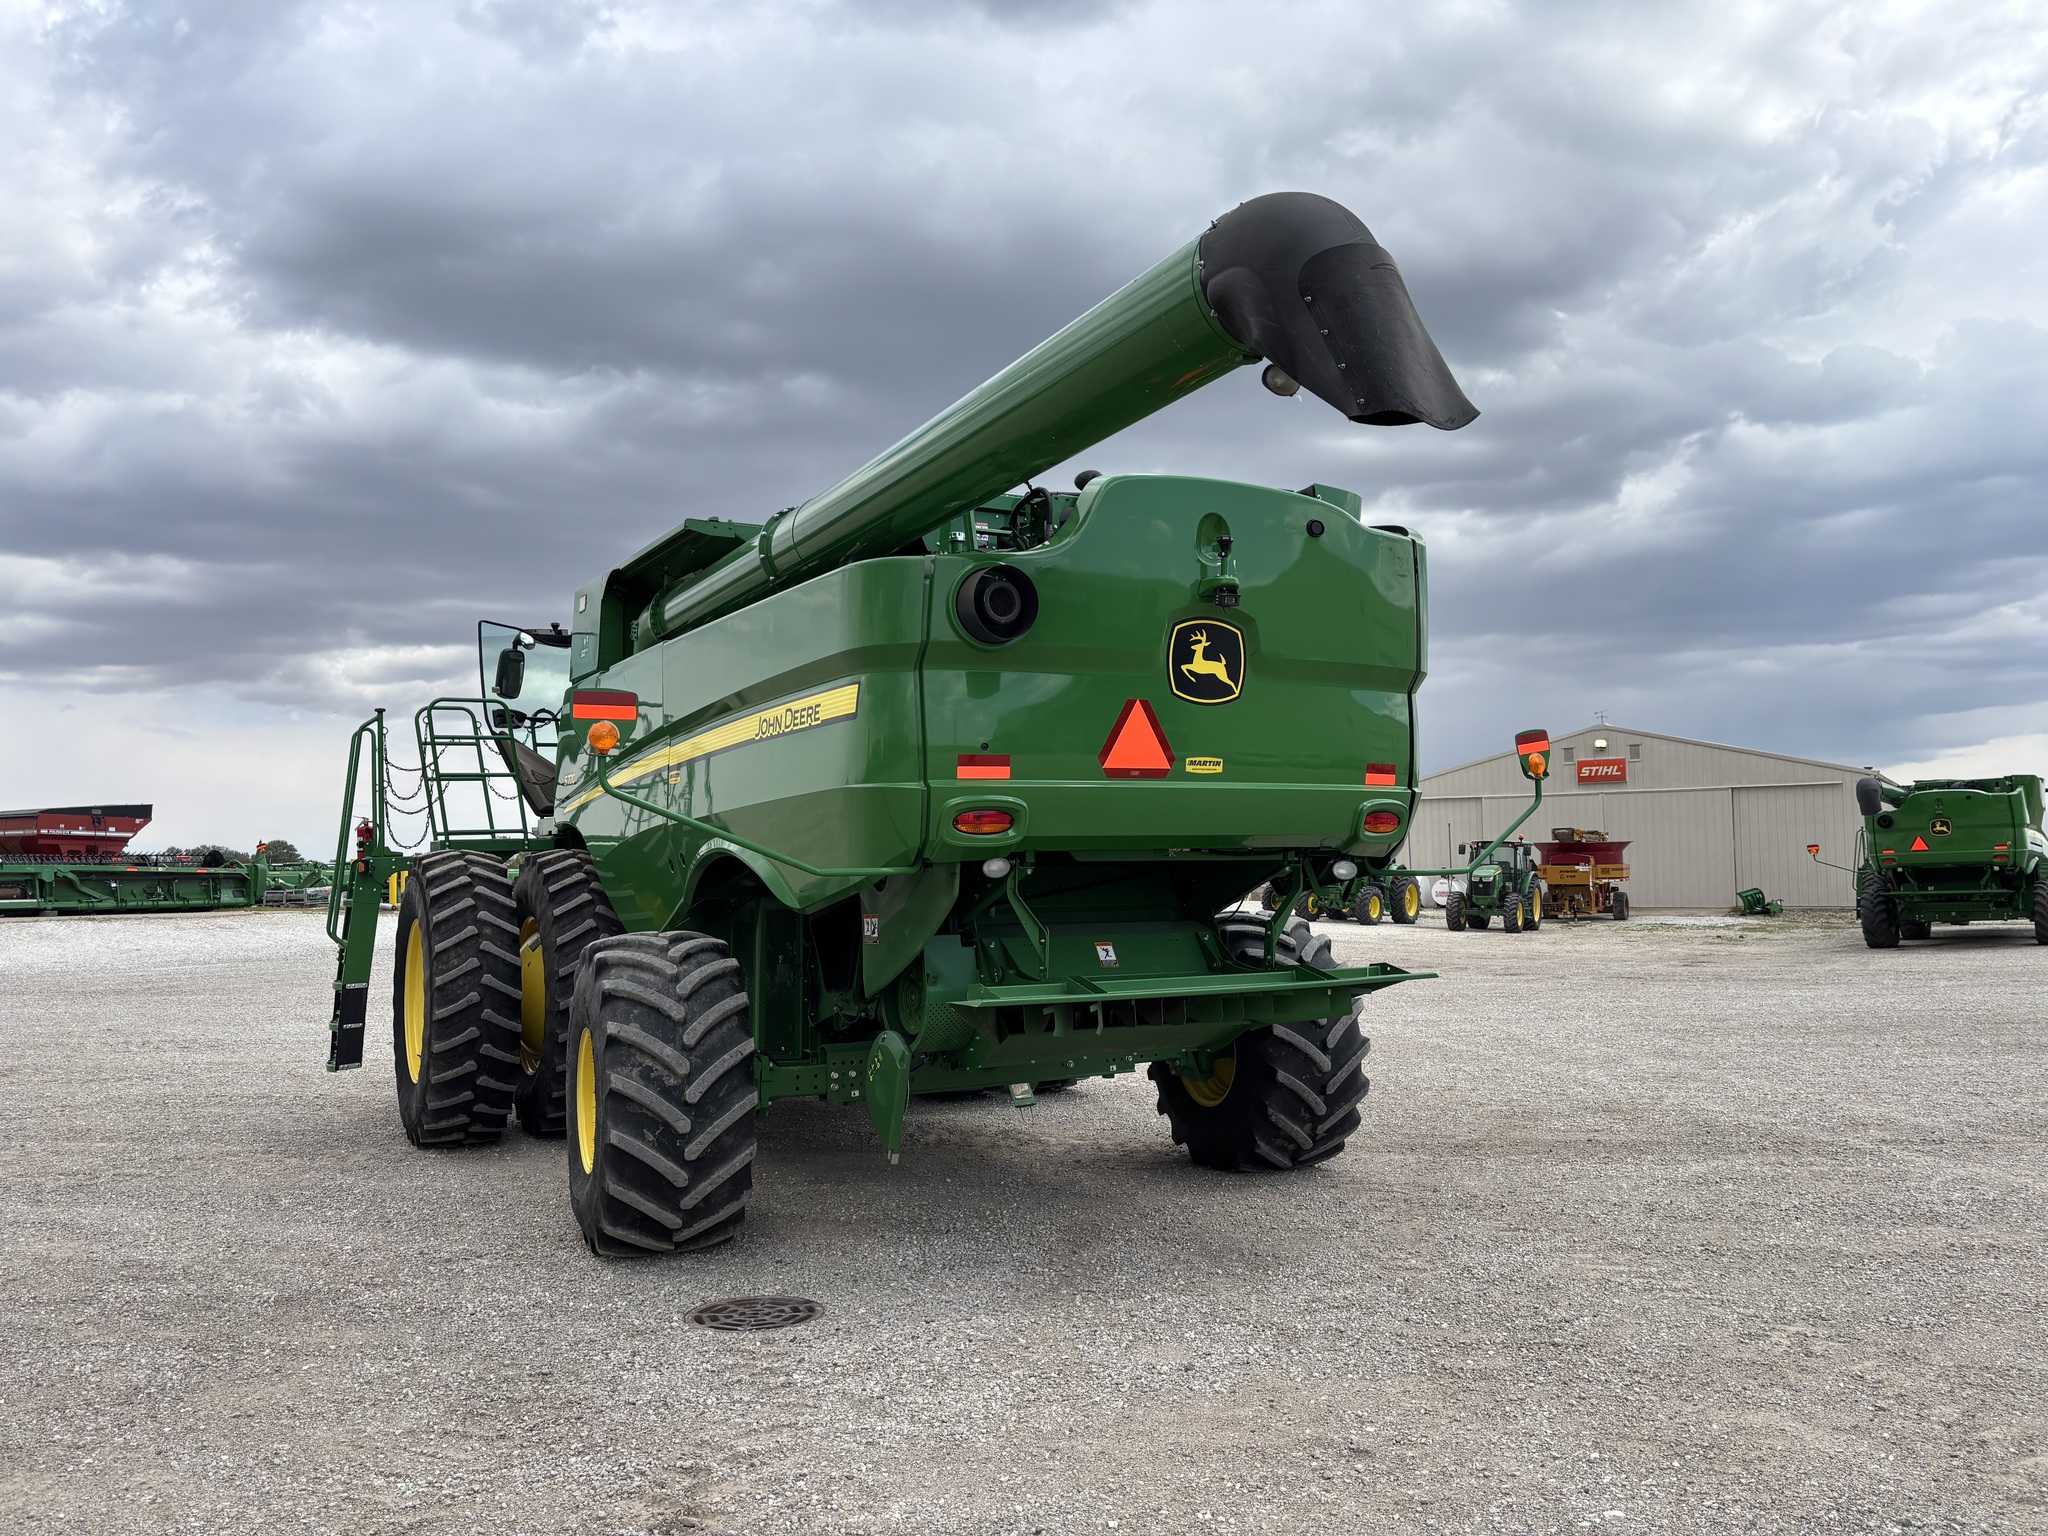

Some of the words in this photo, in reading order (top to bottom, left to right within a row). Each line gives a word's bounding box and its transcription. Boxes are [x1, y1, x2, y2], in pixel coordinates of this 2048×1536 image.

[754, 714, 783, 738] JOHN
[784, 703, 822, 731] DEERE
[1580, 765, 1622, 776] STIHL
